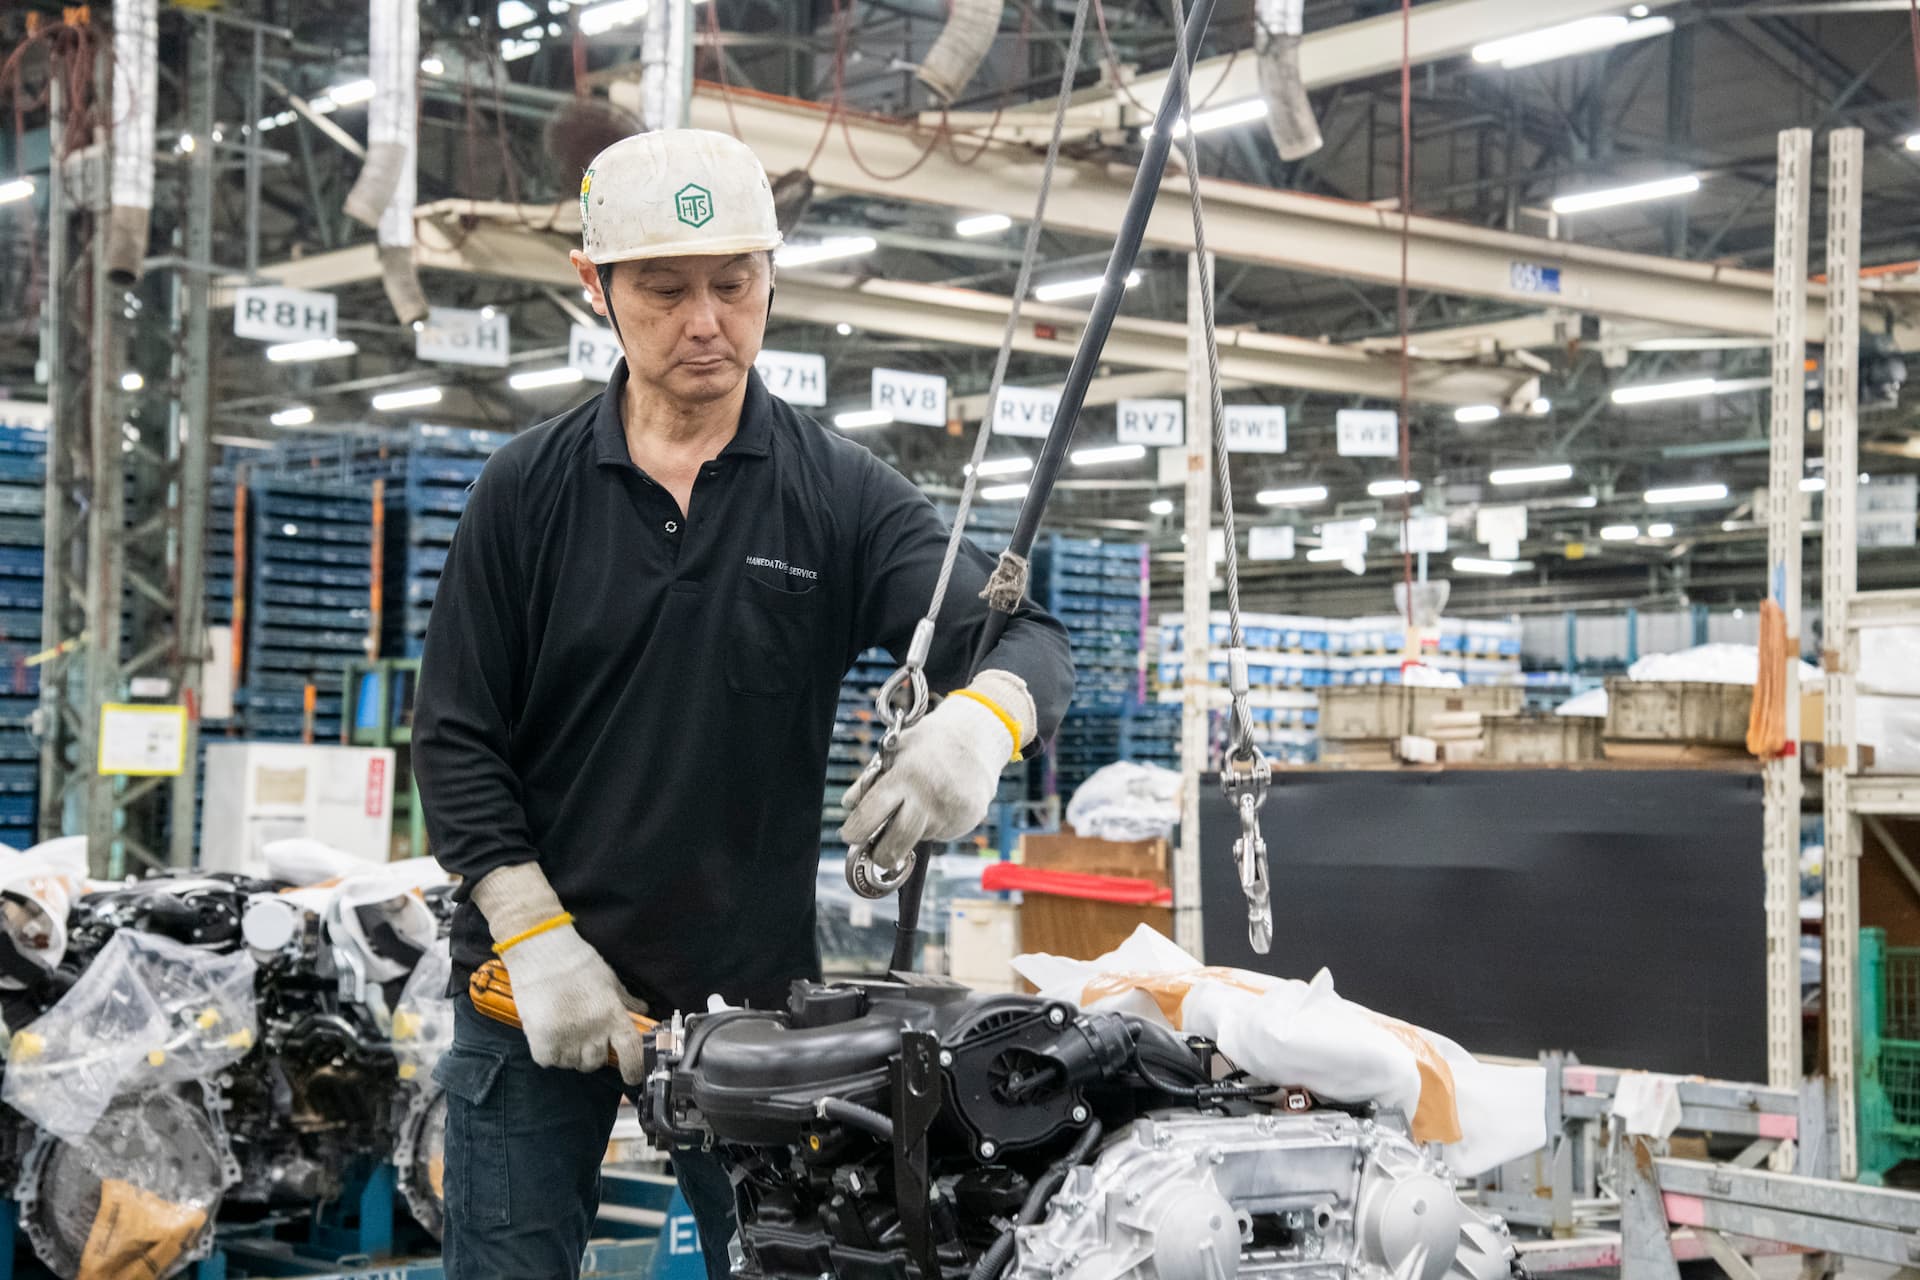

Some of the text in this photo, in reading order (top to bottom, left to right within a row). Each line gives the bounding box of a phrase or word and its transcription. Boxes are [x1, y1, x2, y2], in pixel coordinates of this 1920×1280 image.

[681, 195, 708, 221] HTS
[245, 297, 328, 332] R8H
[880, 384, 938, 410] RV8
[1000, 400, 1056, 424] RV8
[1124, 411, 1177, 433] RV7
[789, 566, 818, 580] SERVICE
